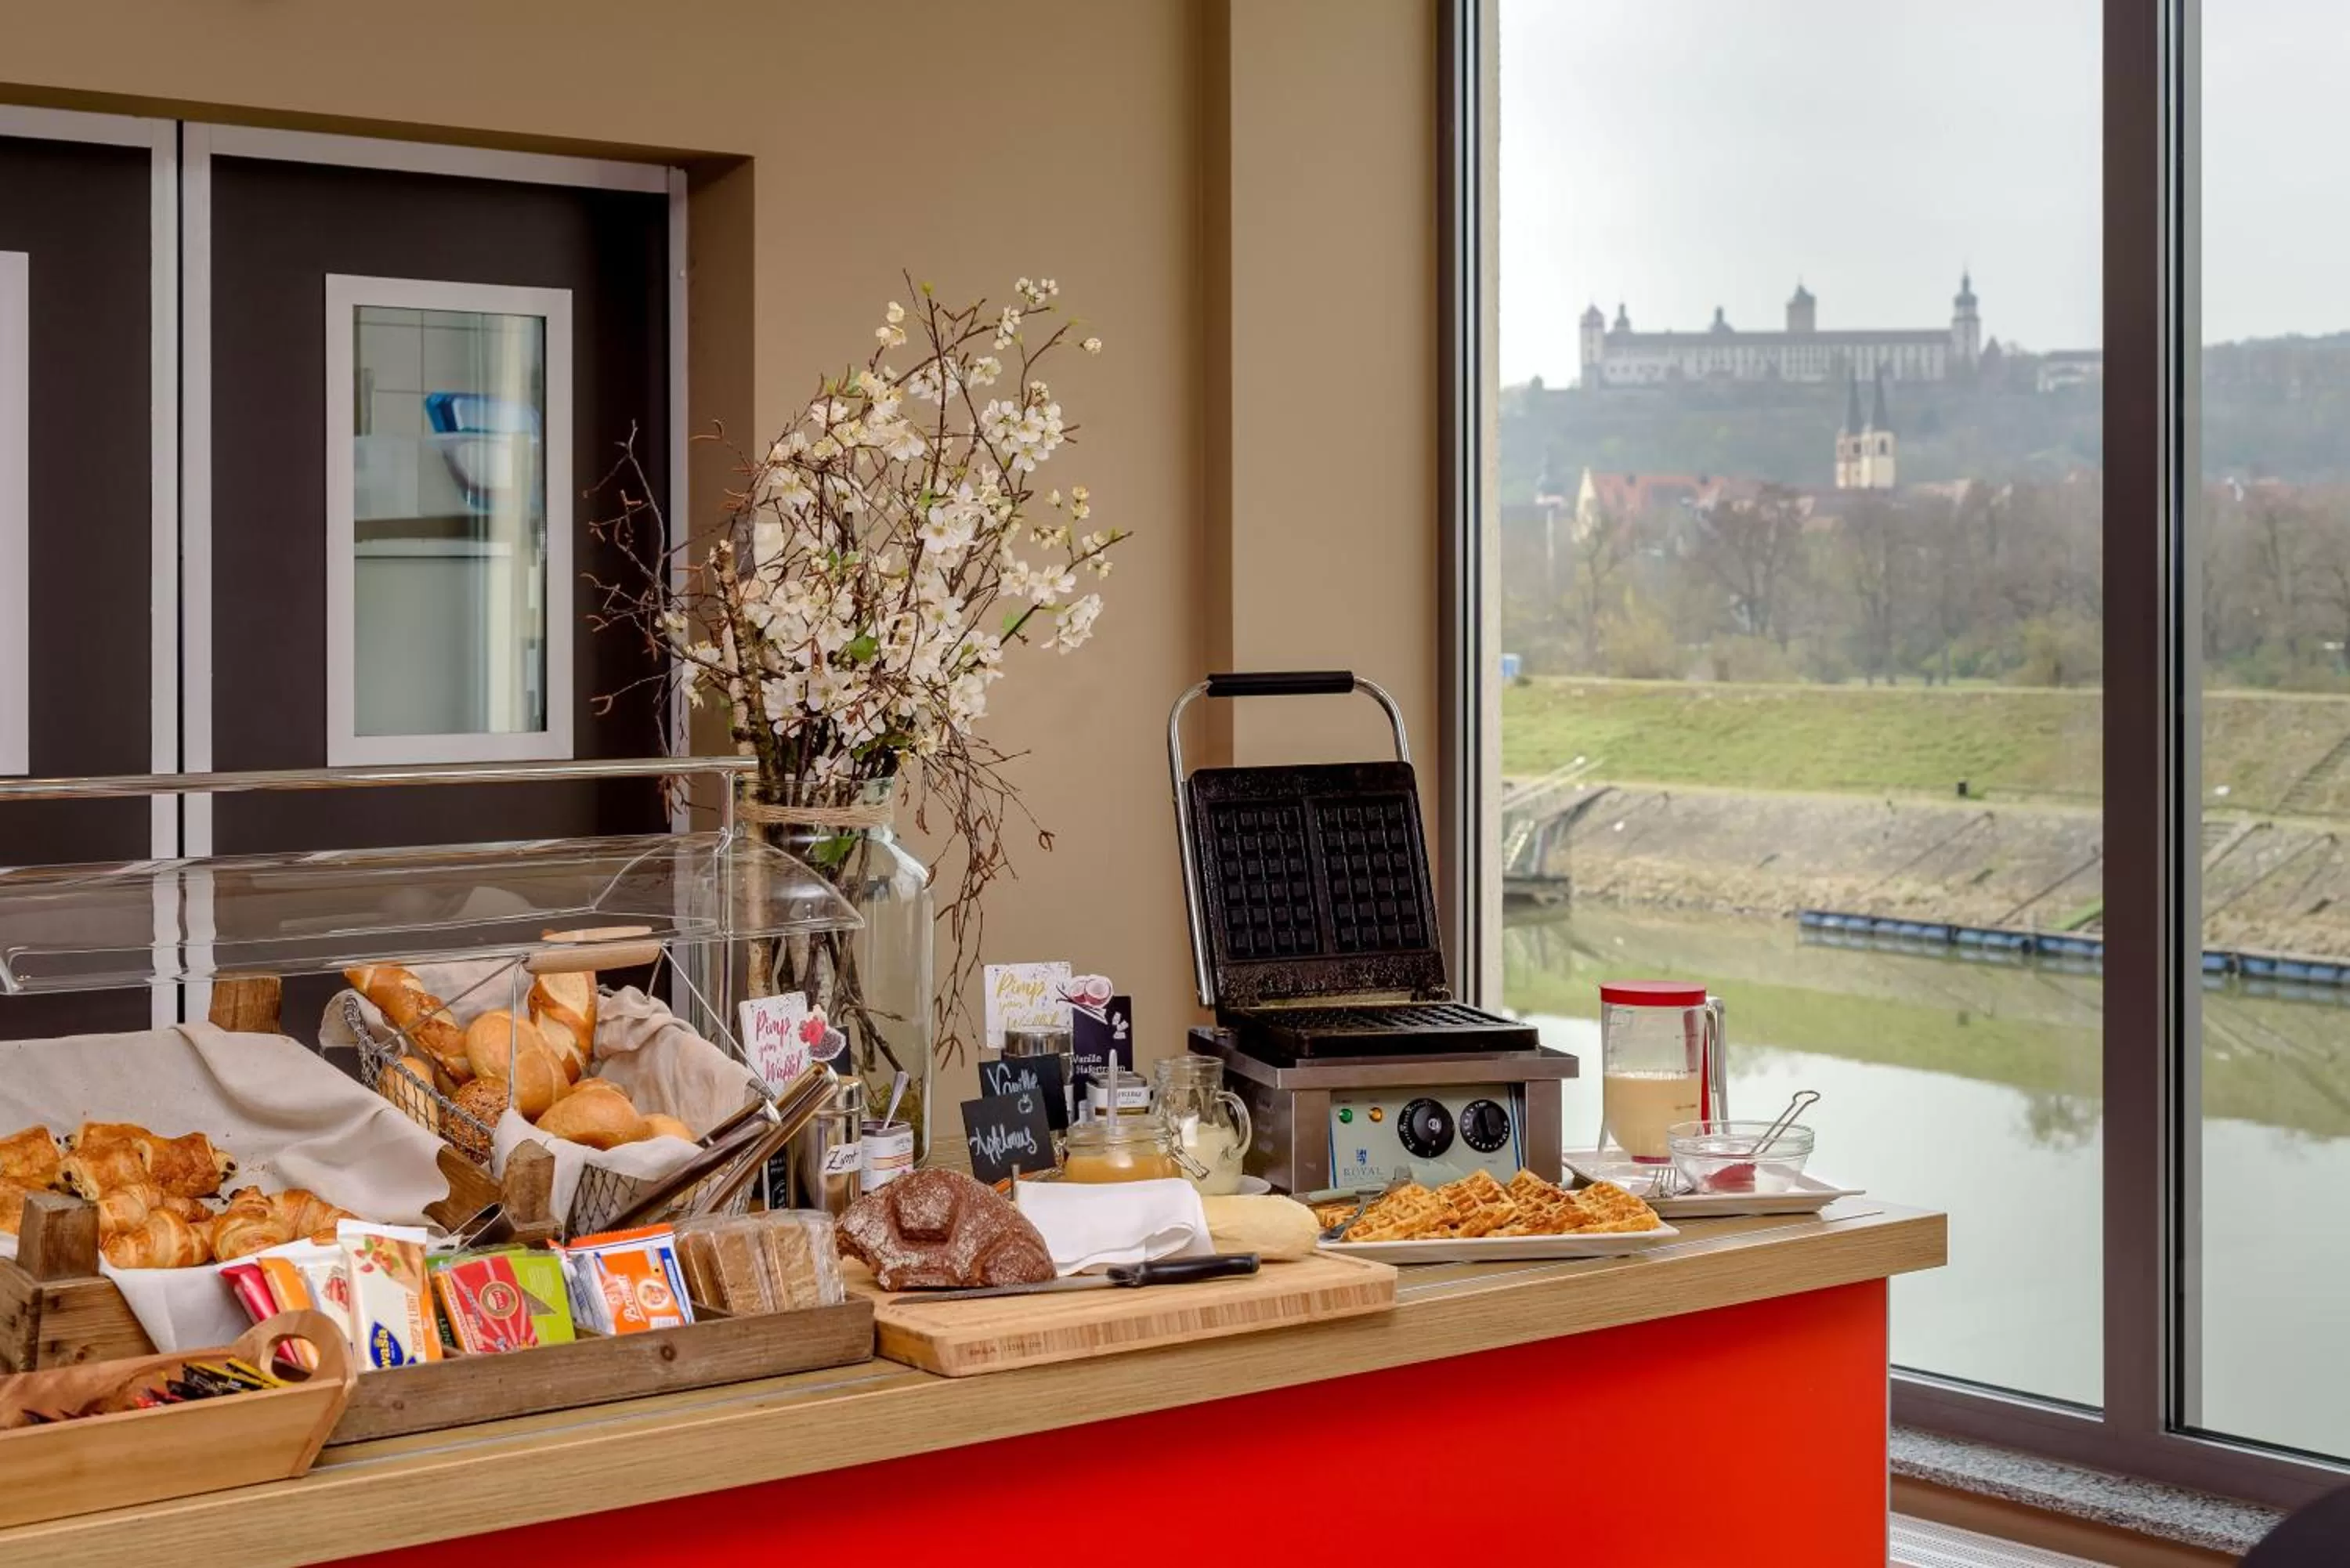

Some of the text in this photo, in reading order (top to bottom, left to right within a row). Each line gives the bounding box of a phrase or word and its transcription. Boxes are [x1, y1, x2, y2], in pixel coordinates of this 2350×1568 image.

[996, 972, 1047, 1006] Pimp
[755, 1010, 791, 1046] Pimp
[1343, 1166, 1385, 1176] ROYAL
[377, 1328, 392, 1367] wasa
